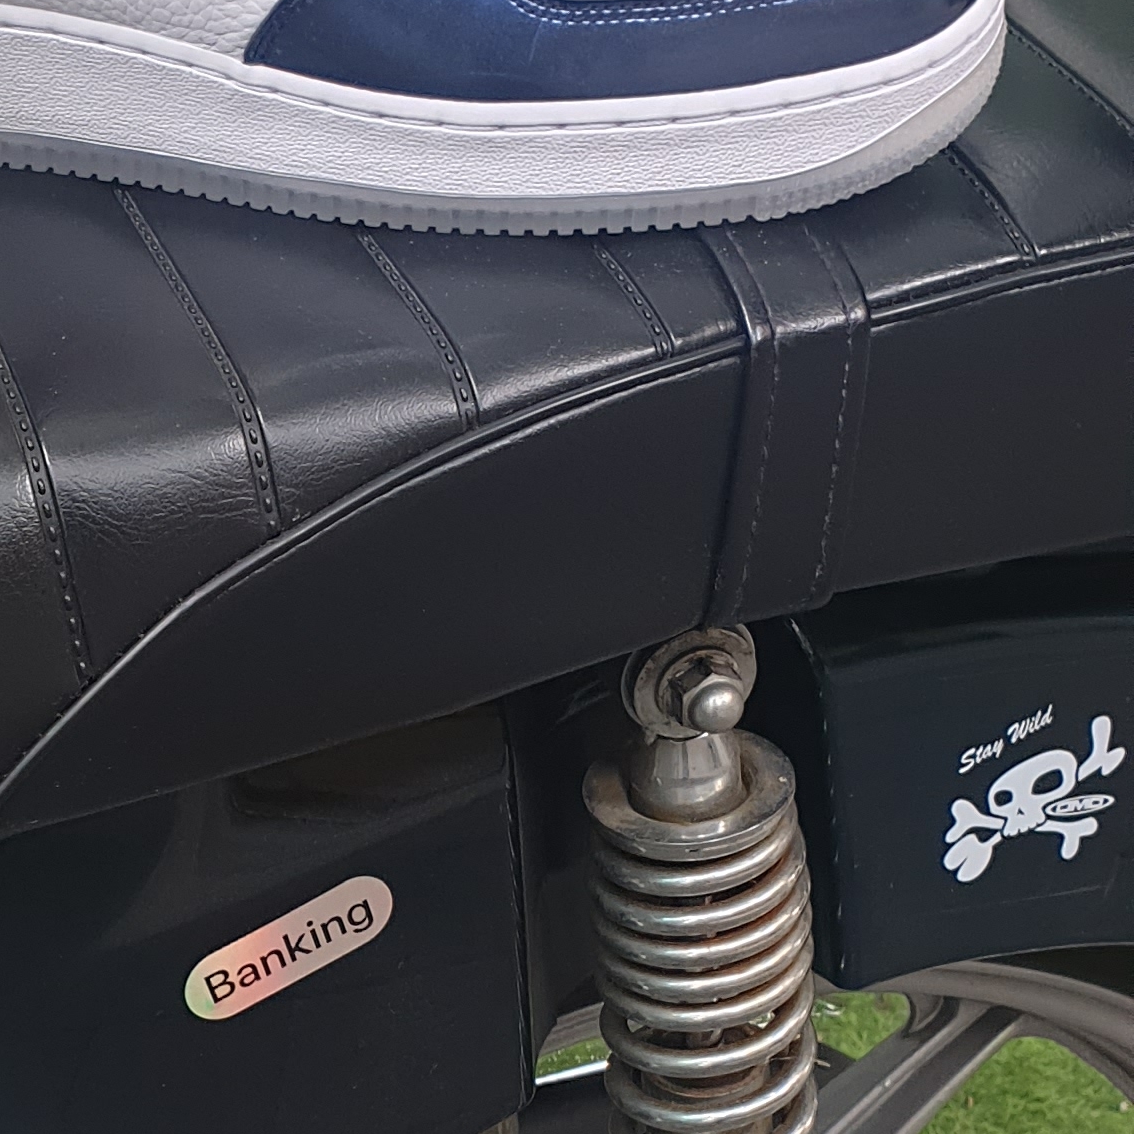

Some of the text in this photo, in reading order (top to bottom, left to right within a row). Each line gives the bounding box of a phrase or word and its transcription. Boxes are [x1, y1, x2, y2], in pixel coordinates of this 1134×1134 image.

[959, 703, 1053, 774] Stay Wild
[204, 899, 374, 1004] Banking
